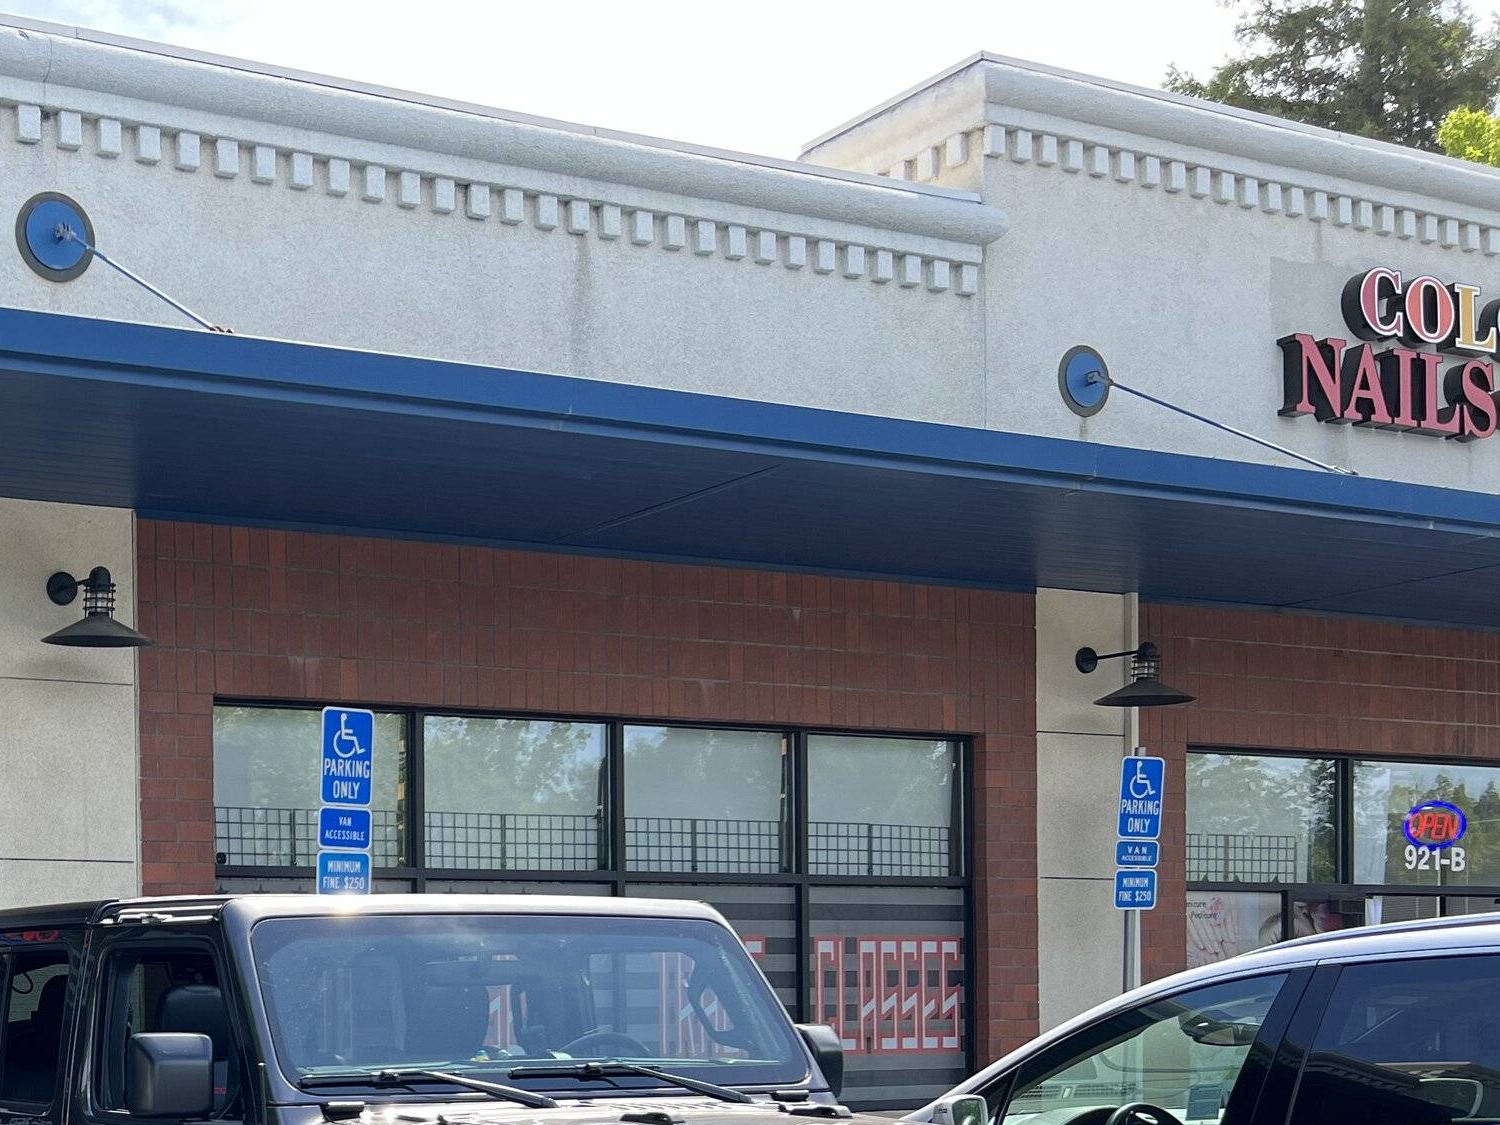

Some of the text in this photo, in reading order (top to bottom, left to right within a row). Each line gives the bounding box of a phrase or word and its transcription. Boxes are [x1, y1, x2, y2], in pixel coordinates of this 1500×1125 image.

[1358, 266, 1500, 353] COL
[1292, 332, 1497, 438] NAILS
[324, 758, 371, 779] PARKING
[332, 780, 361, 800] ONLY
[1120, 798, 1160, 816] PARKING
[338, 816, 352, 827] VAN
[1127, 818, 1151, 834] ONLY
[1409, 811, 1460, 840] OPEN
[324, 829, 365, 842] ACCESSIBLE
[1127, 845, 1148, 855] VAN
[1404, 844, 1466, 872] 921-B
[327, 860, 361, 873] MINIMUM
[322, 876, 365, 890] FINE $250
[1122, 877, 1149, 888] MINIMUM
[1118, 890, 1152, 903] FINE $250
[815, 935, 960, 1053] CLASSES
